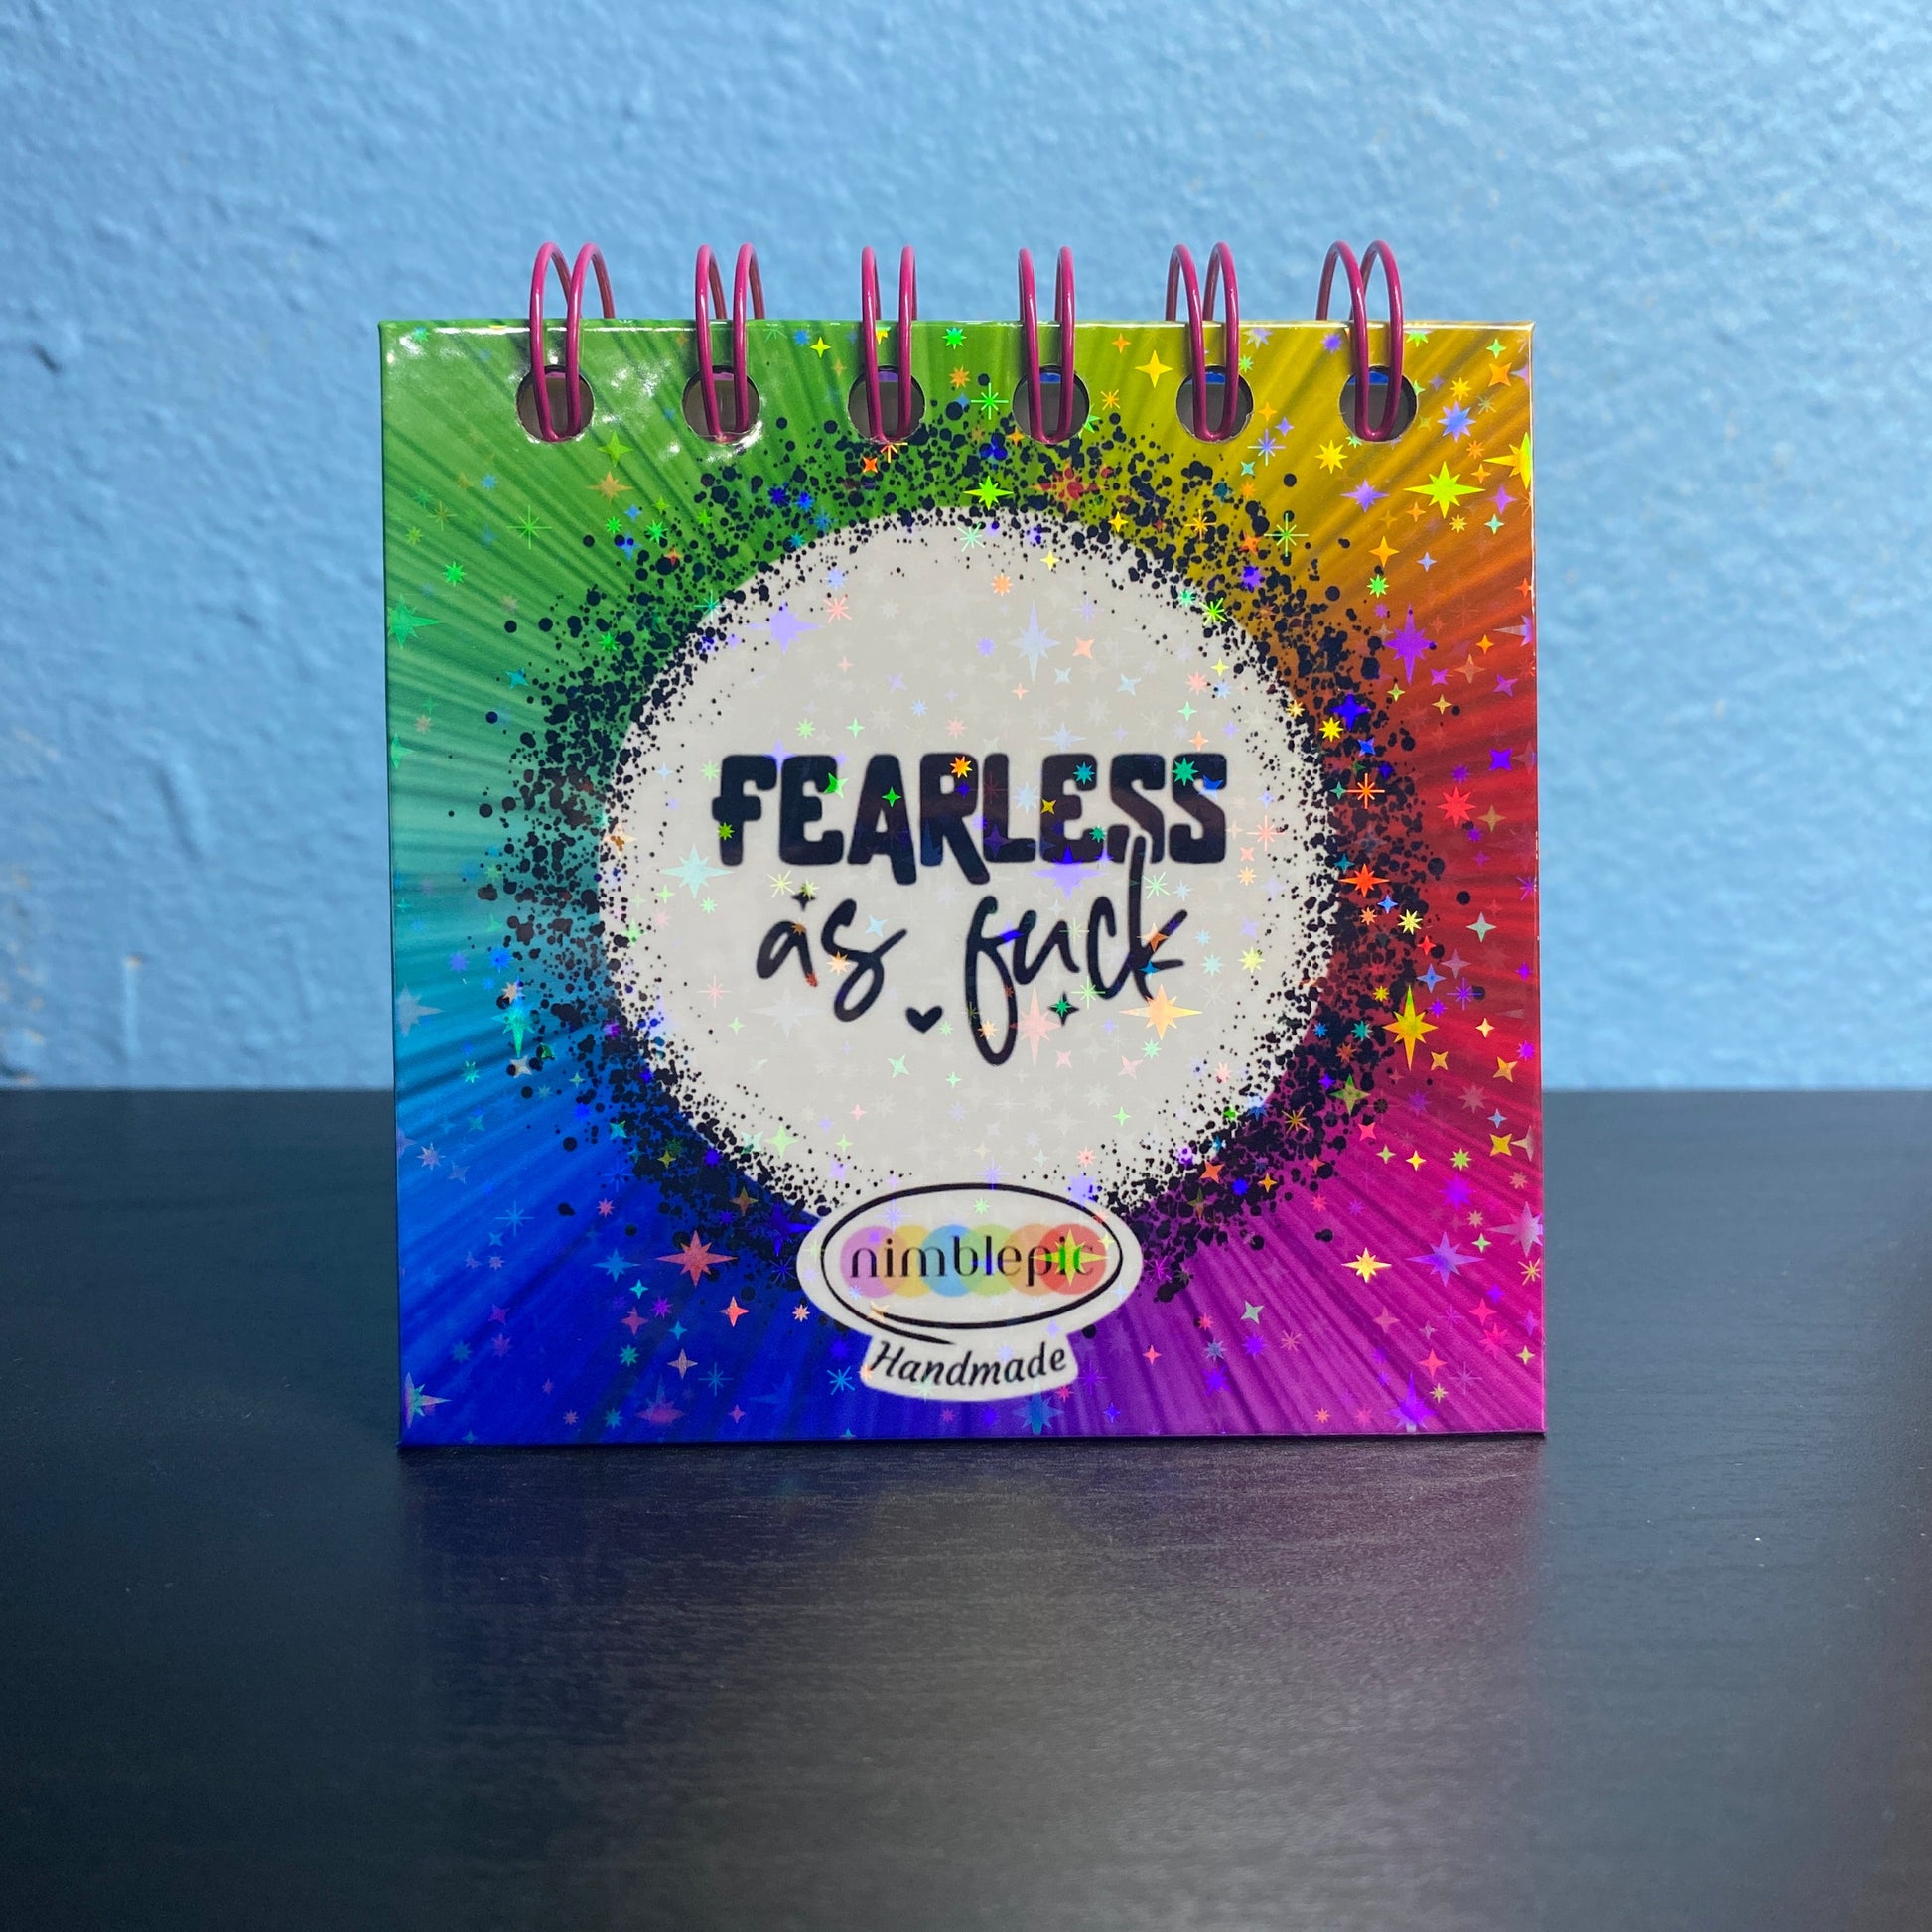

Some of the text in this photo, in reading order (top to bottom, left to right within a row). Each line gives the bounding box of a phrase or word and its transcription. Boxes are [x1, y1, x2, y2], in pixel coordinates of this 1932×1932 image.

[712, 753, 1227, 885] FEARLESS
[757, 836, 1188, 1066] as fuck
[850, 1235, 1094, 1288] nimblepic
[871, 1340, 1067, 1387] Handmade
